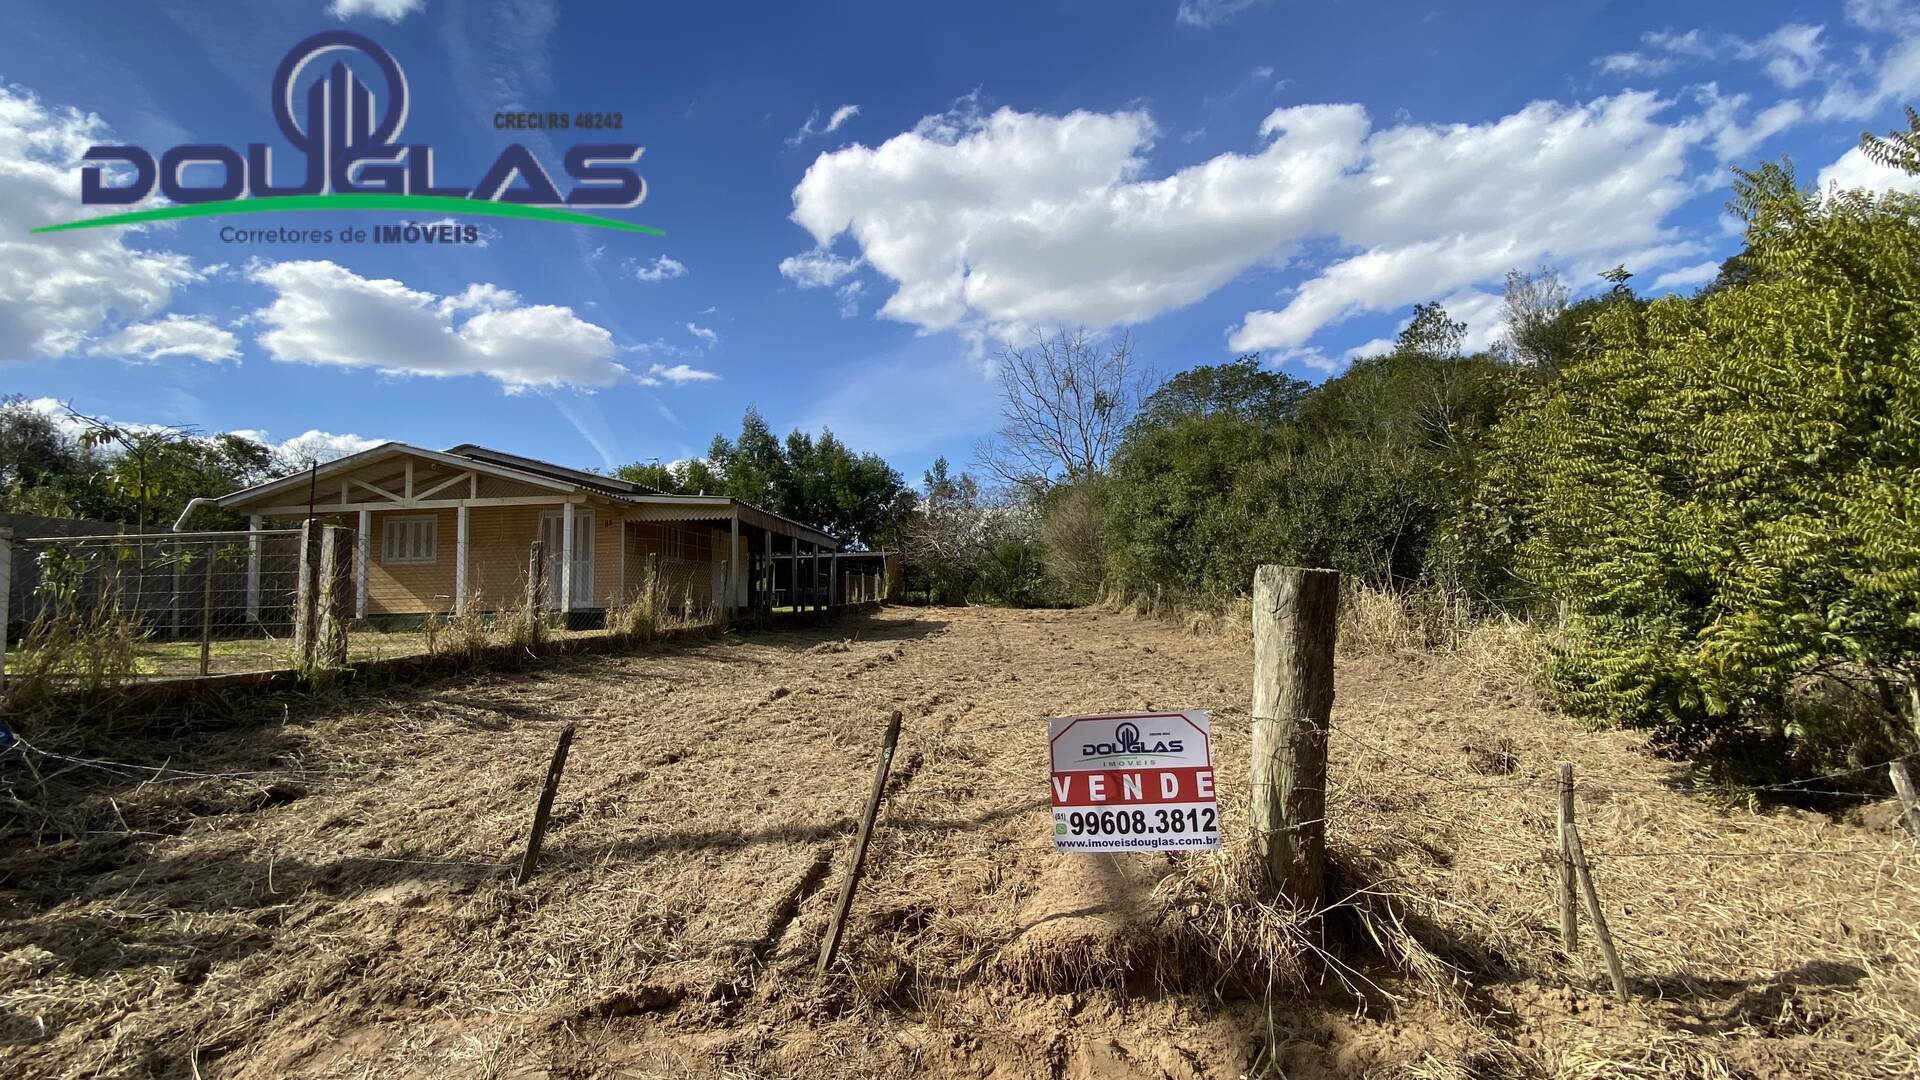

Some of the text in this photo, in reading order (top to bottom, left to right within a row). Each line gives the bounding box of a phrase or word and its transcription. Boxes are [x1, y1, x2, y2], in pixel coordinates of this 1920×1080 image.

[1082, 740, 1184, 756] DOUGLAS
[1052, 771, 1214, 803] VENDE
[1070, 808, 1217, 835] 99608.3812
[1057, 836, 1217, 848] www.imoveisdouglas.com.br
